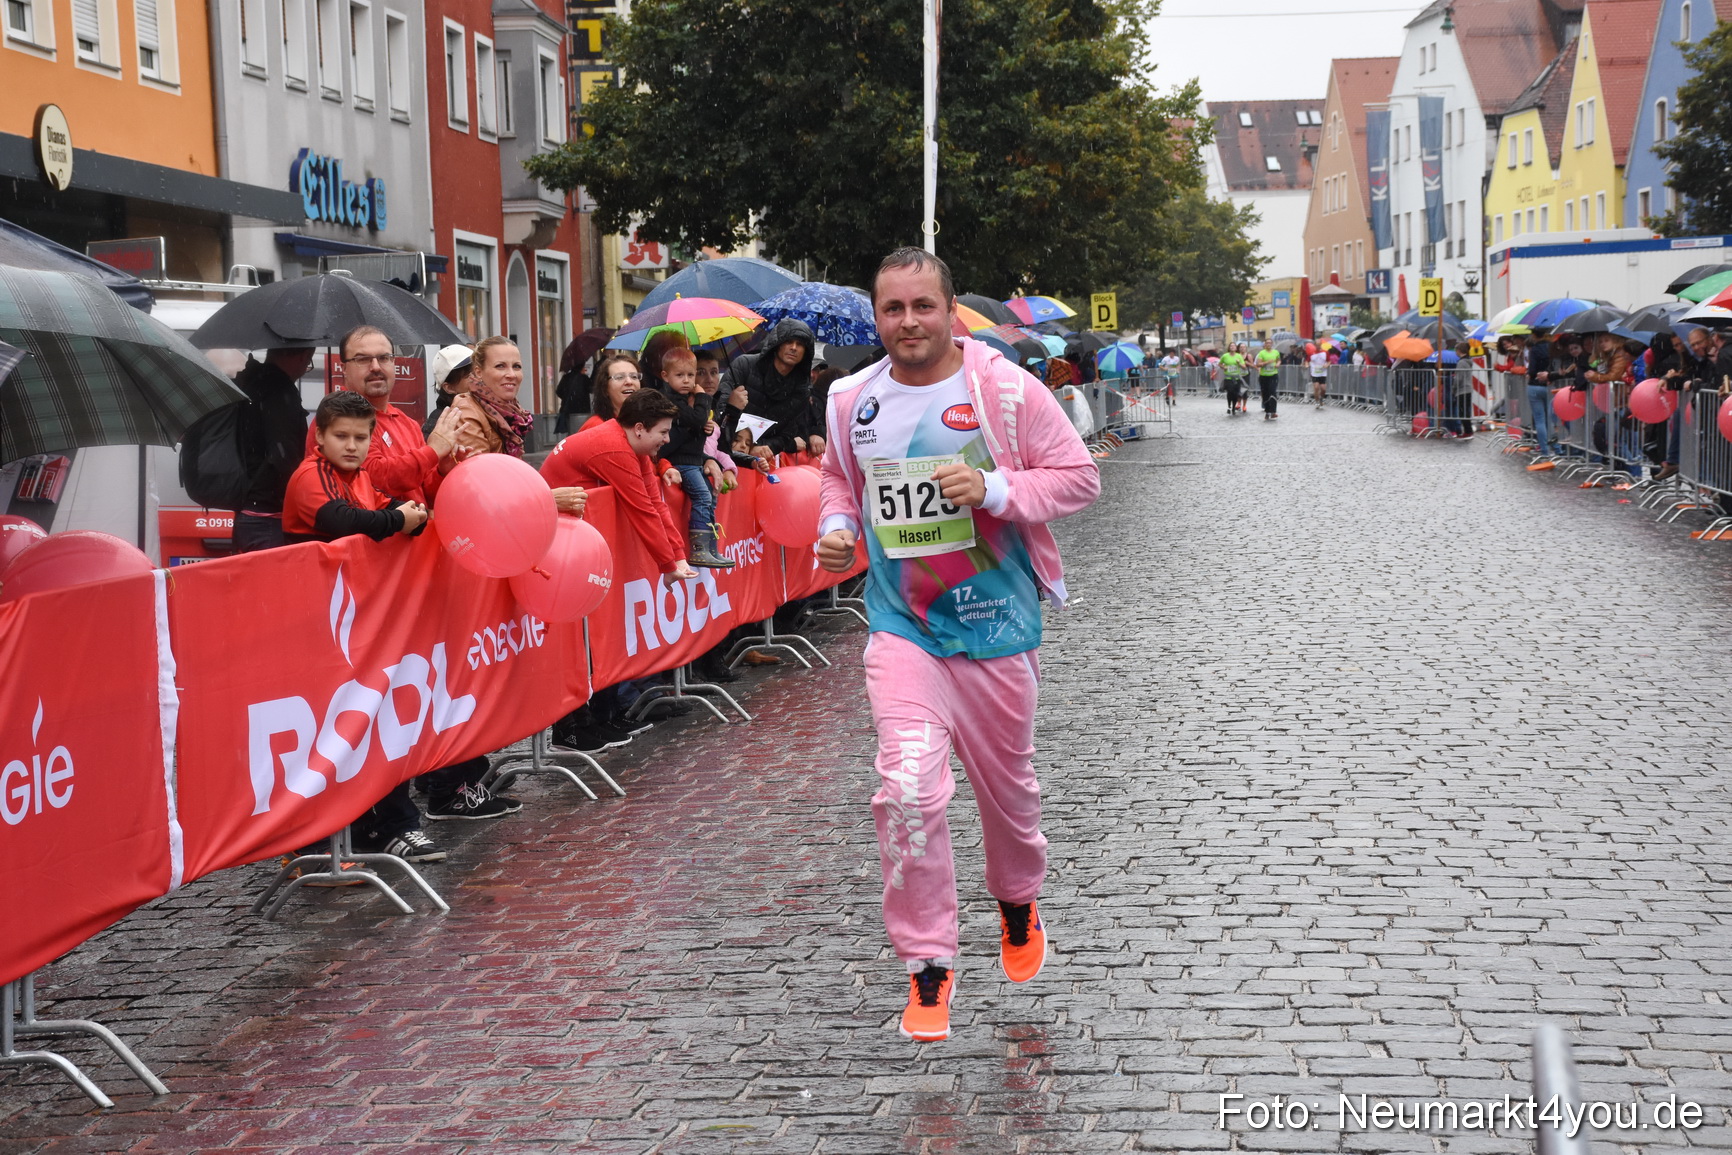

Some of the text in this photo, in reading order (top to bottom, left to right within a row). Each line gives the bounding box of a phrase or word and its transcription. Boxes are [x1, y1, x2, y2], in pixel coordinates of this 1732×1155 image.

[46, 126, 66, 145] Dianas
[297, 147, 370, 227] Eilles
[1093, 294, 1113, 303] Block
[1425, 289, 1437, 308] D
[1098, 304, 1110, 322] D
[855, 429, 877, 439] PARTL
[899, 527, 942, 544] Haserl
[952, 586, 977, 603] 17.
